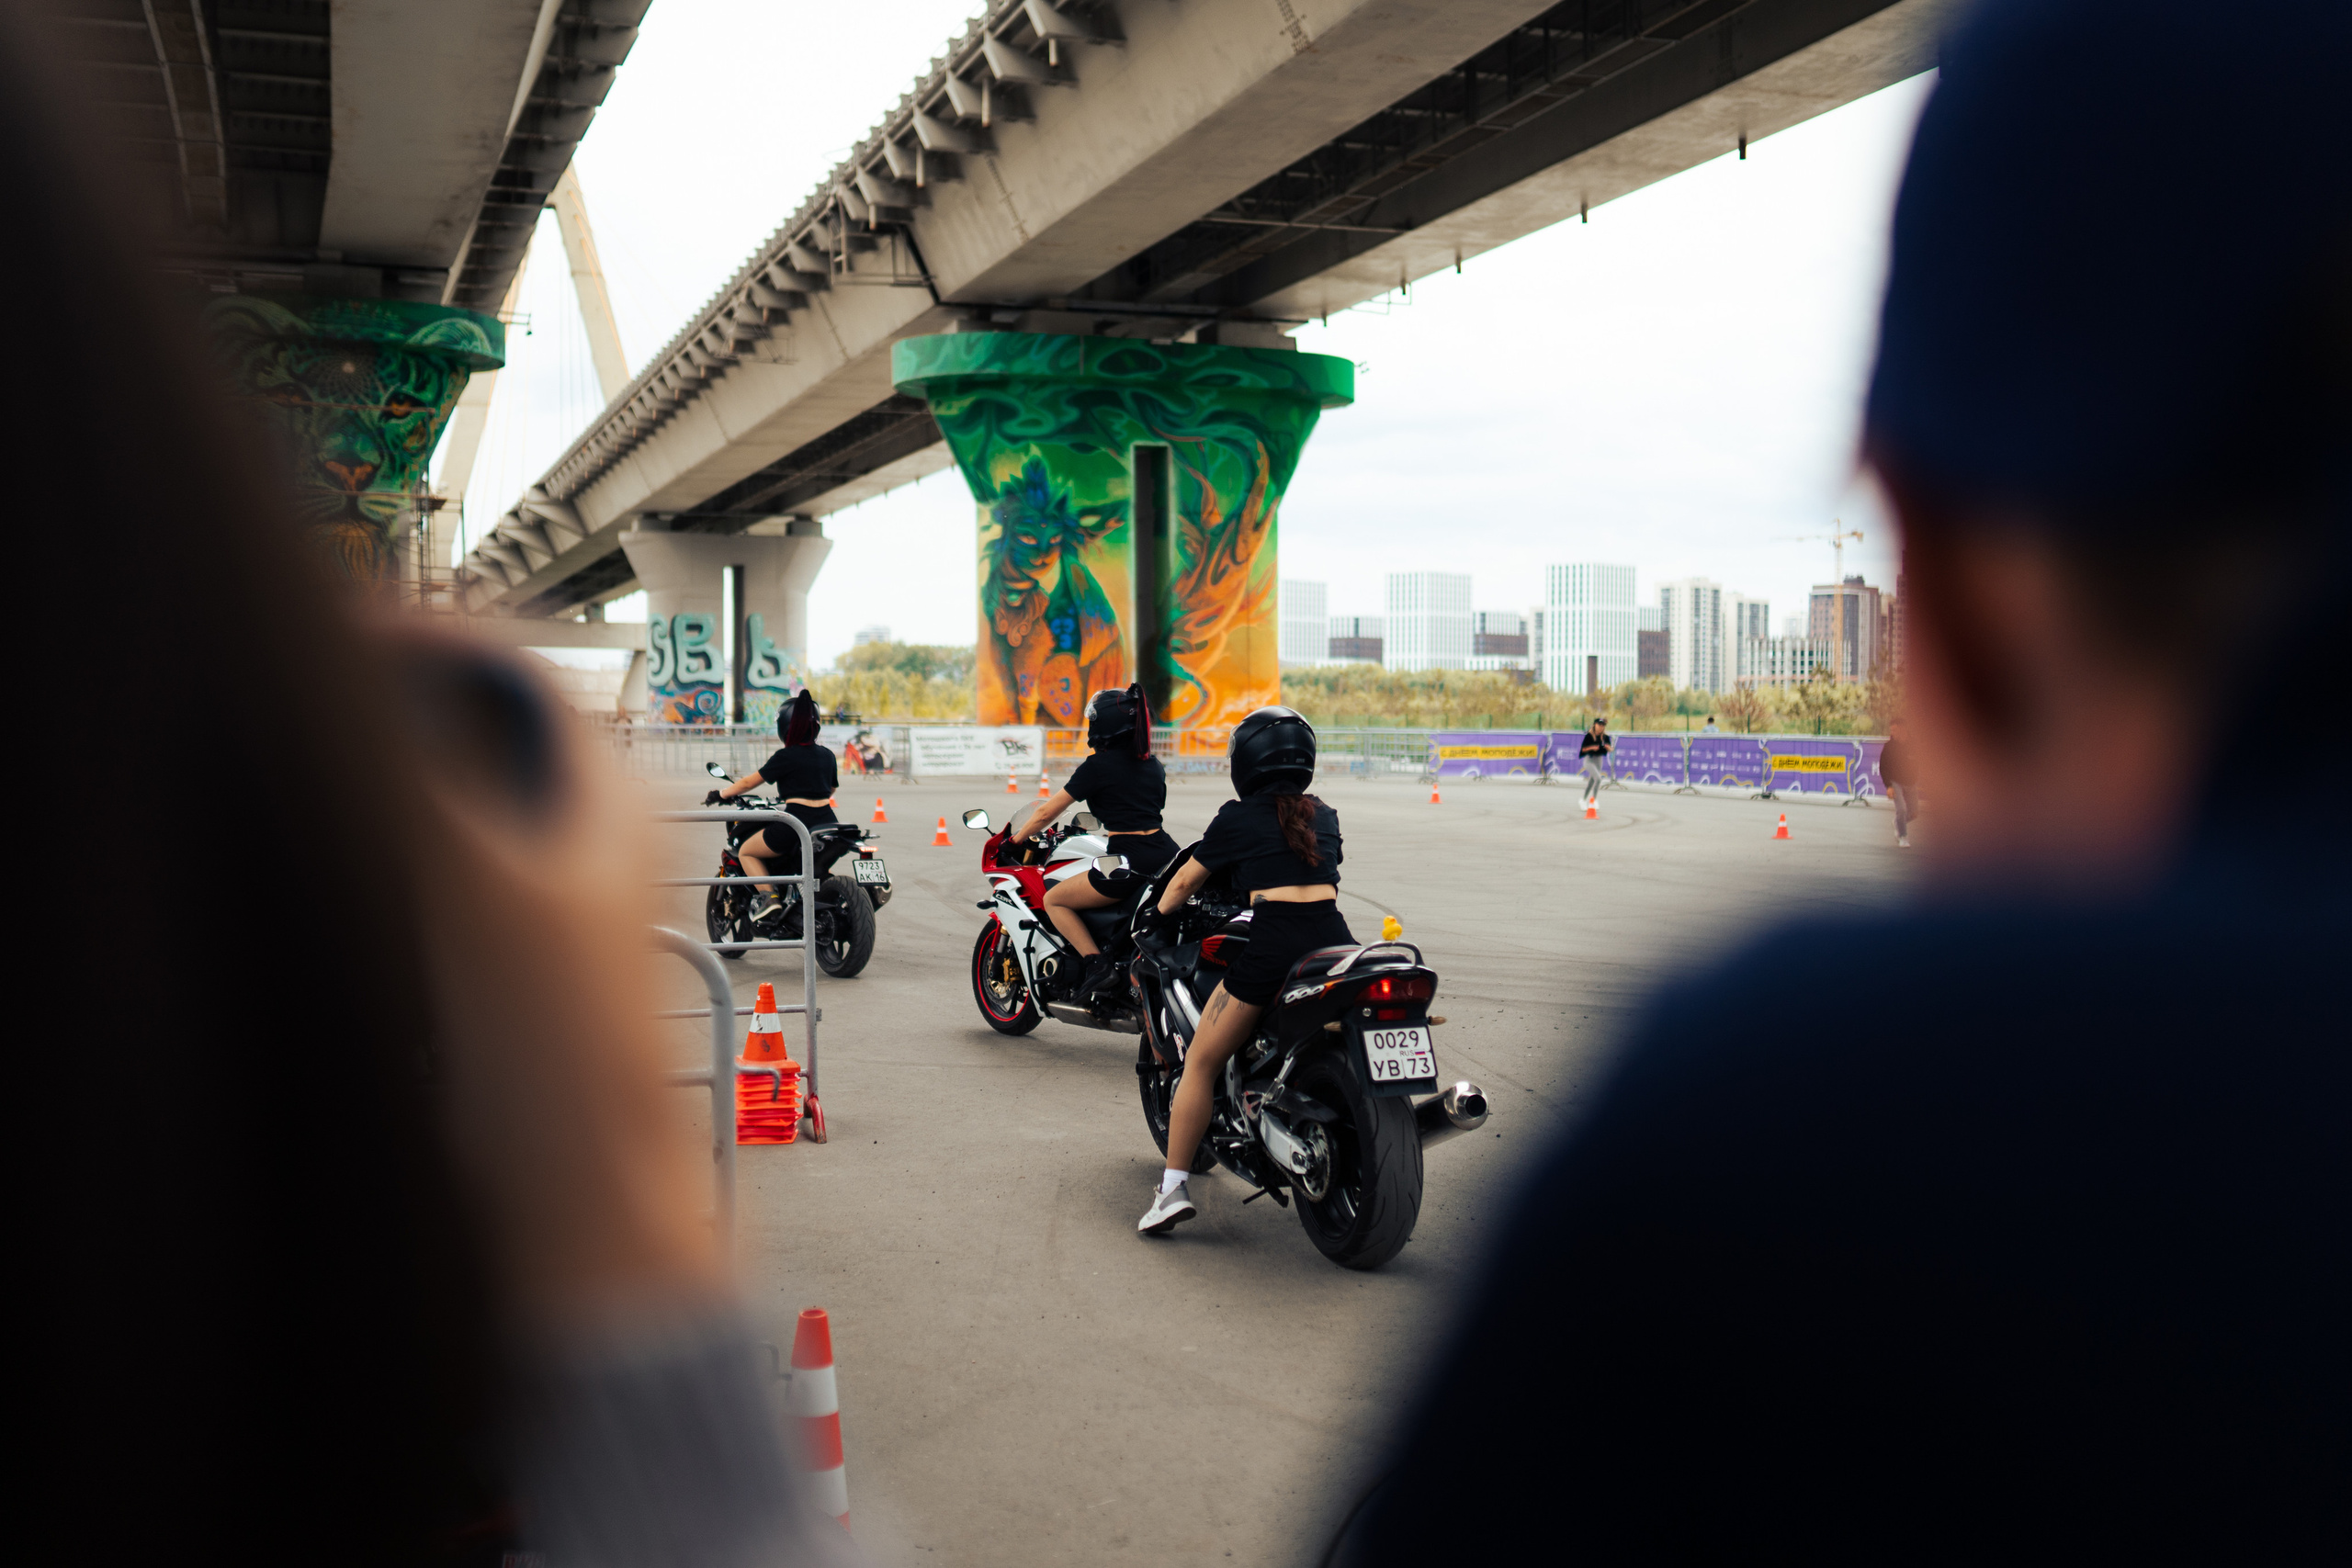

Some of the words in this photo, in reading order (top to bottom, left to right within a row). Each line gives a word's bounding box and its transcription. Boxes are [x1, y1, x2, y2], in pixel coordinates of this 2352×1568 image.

[858, 862, 880, 870] 9723
[860, 873, 873, 882] AK
[875, 873, 886, 882] 16
[1200, 952, 1228, 967] HONDA
[1374, 1030, 1419, 1049] 0029
[1373, 1059, 1401, 1077] YB
[1407, 1057, 1430, 1076] 73
